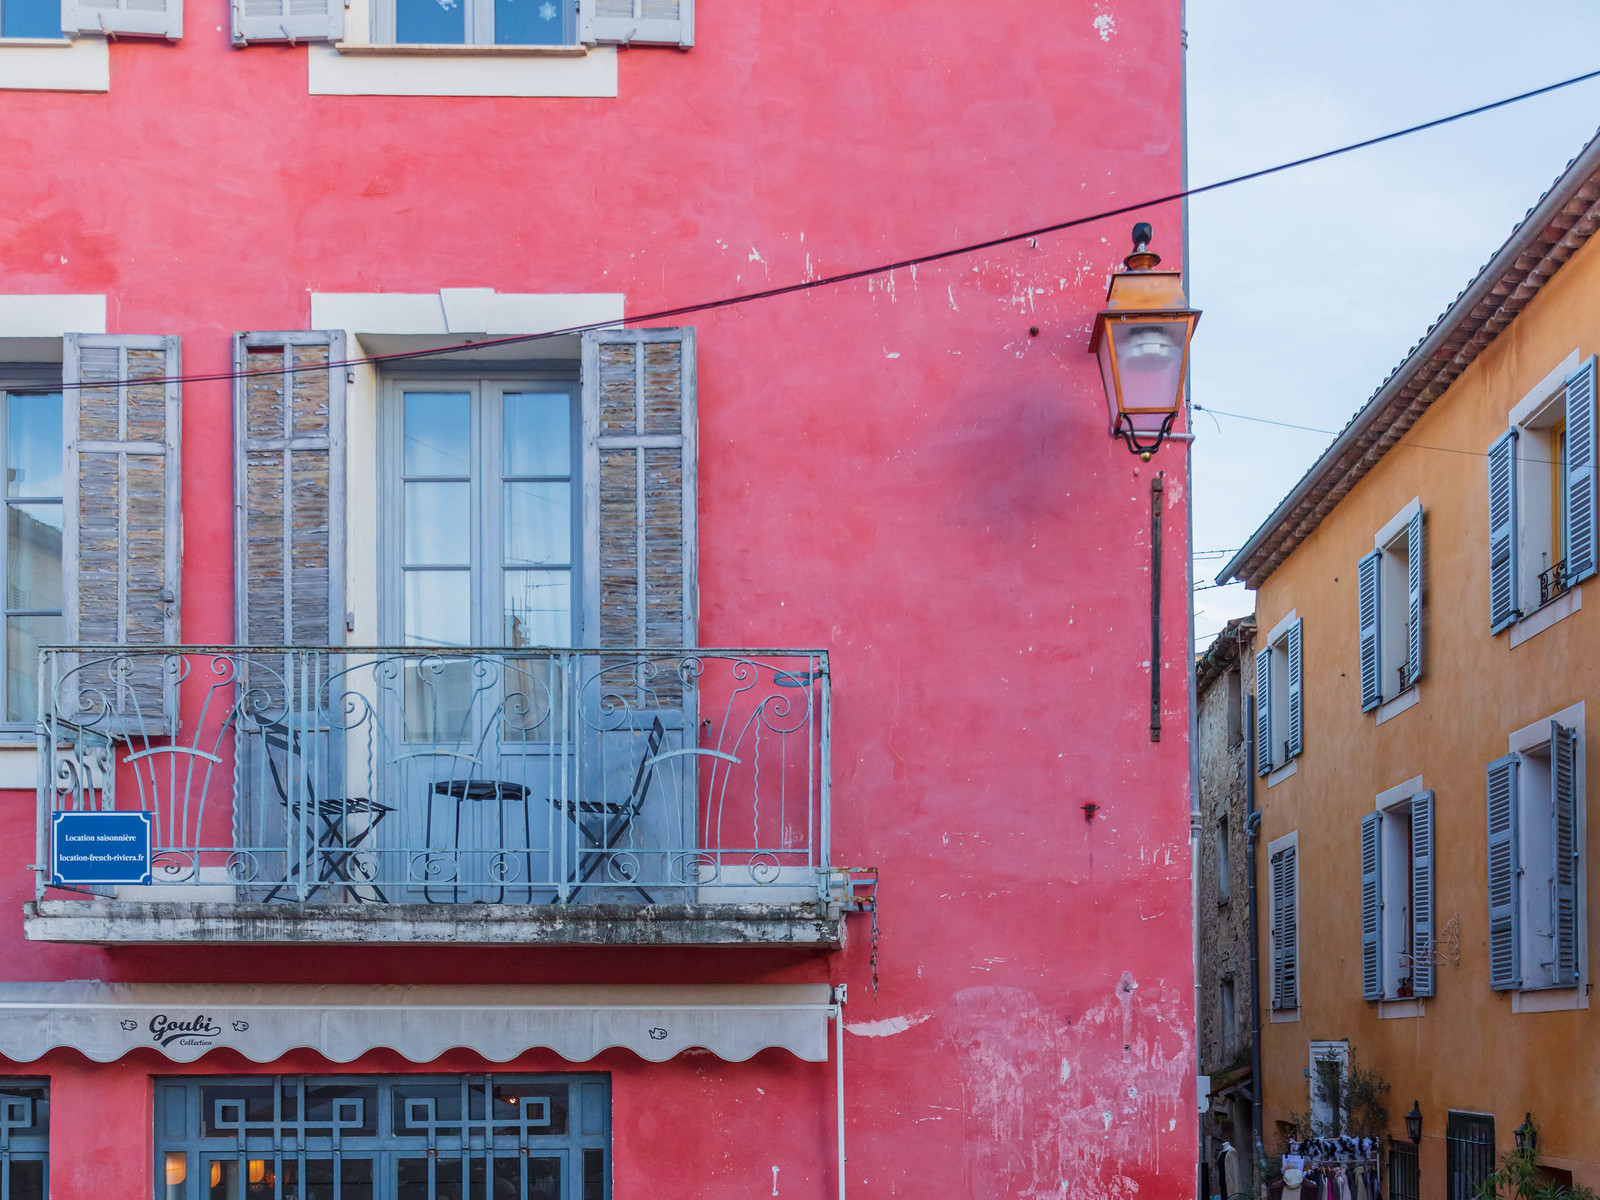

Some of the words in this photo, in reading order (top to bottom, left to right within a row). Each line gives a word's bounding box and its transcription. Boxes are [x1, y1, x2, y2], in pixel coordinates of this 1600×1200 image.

[65, 834, 95, 842] Location
[96, 833, 137, 842] saisonnière
[59, 853, 145, 862] location-french-riviera.fr
[149, 1014, 221, 1042] Goubi
[179, 1038, 212, 1046] Collection
